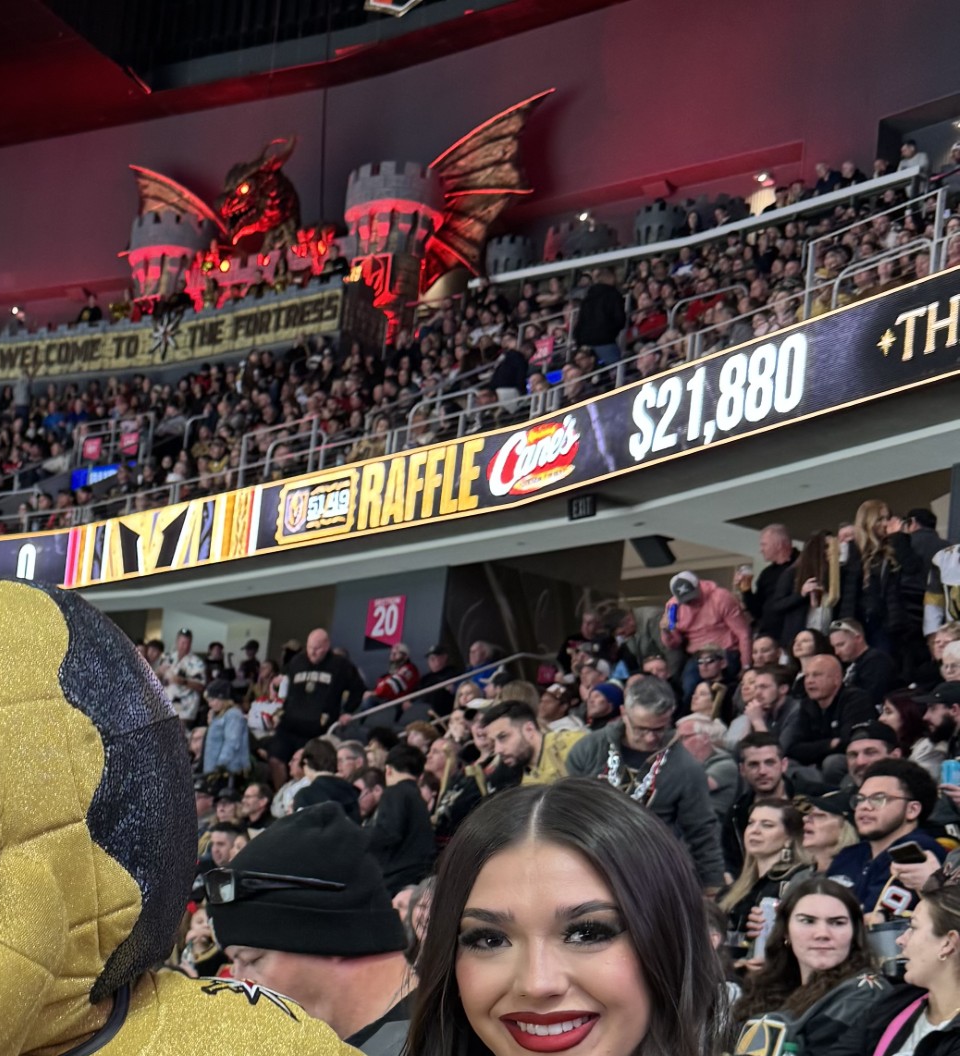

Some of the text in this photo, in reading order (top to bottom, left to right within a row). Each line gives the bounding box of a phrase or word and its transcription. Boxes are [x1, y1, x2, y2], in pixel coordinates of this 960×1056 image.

[112, 335, 139, 359] TO
[188, 320, 226, 348] THE
[232, 293, 340, 340] FORTRESS
[629, 332, 808, 461] $21,880
[356, 437, 485, 531] RAFFLE
[572, 496, 594, 518] EXIT
[371, 604, 399, 637] 20
